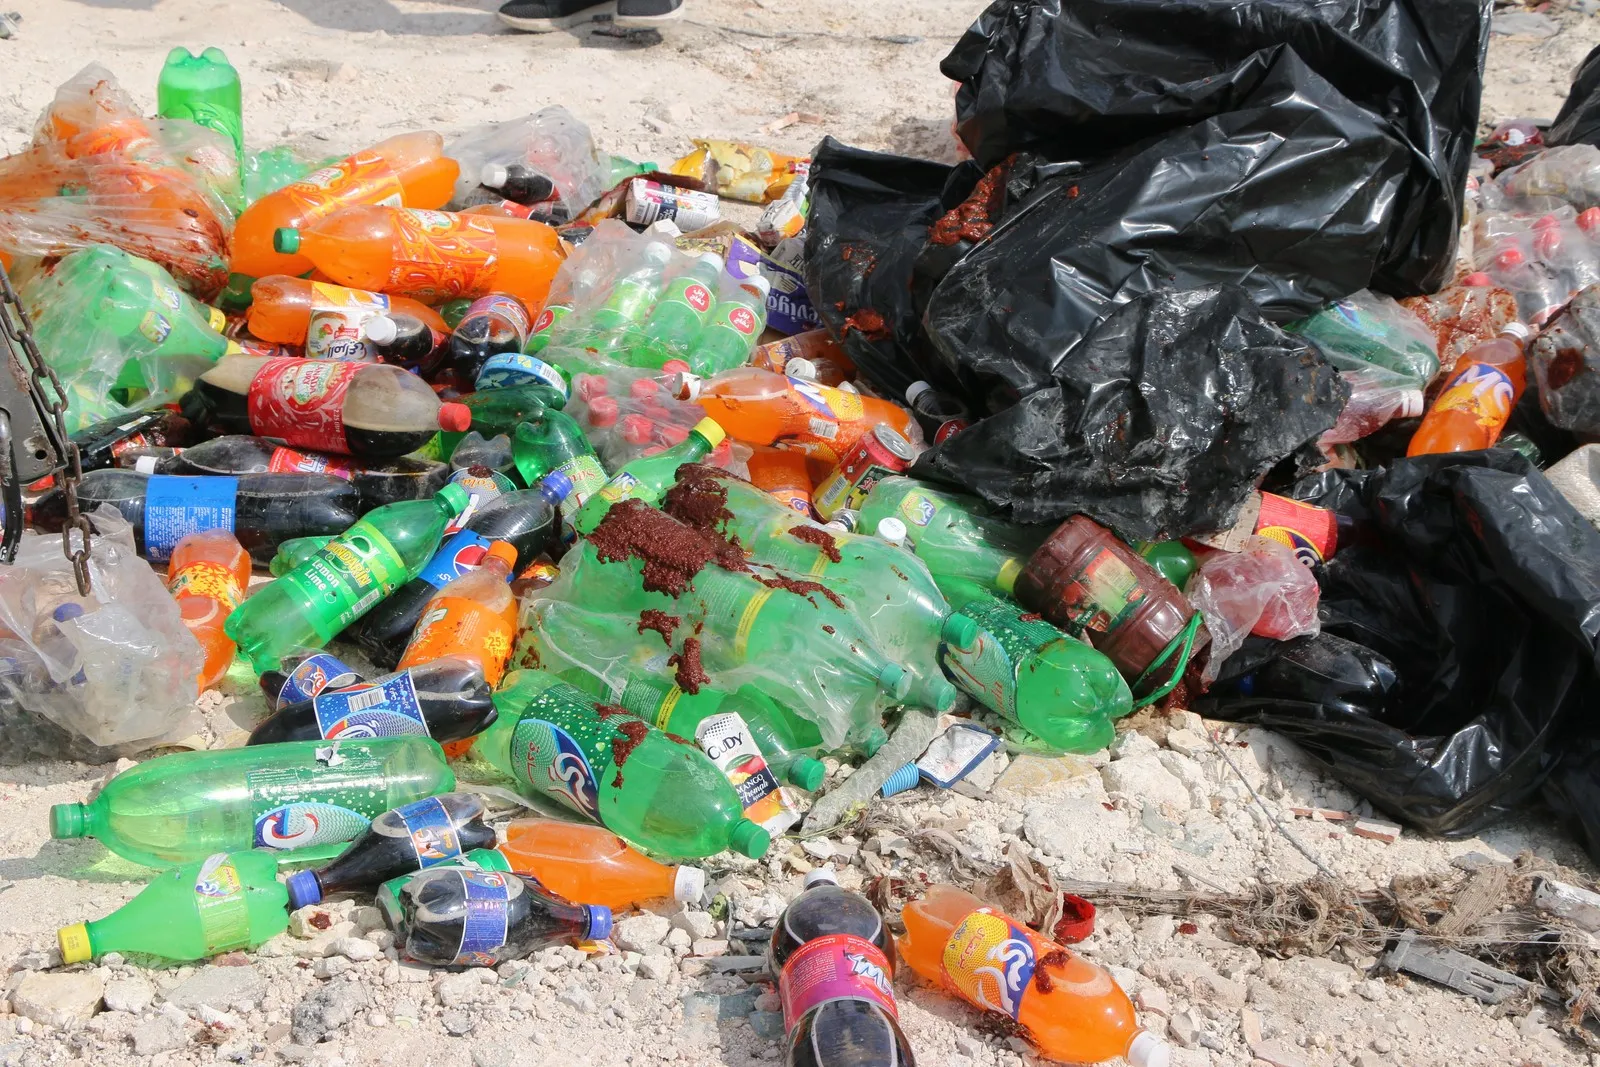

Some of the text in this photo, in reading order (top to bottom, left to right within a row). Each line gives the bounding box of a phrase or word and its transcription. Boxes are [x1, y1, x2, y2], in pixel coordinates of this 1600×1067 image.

[327, 341, 366, 358] المراعي
[303, 370, 313, 385] DRY
[304, 568, 327, 591] Lime
[312, 559, 340, 588] Lemon
[706, 732, 744, 761] CUDY
[735, 773, 765, 795] MANGO
